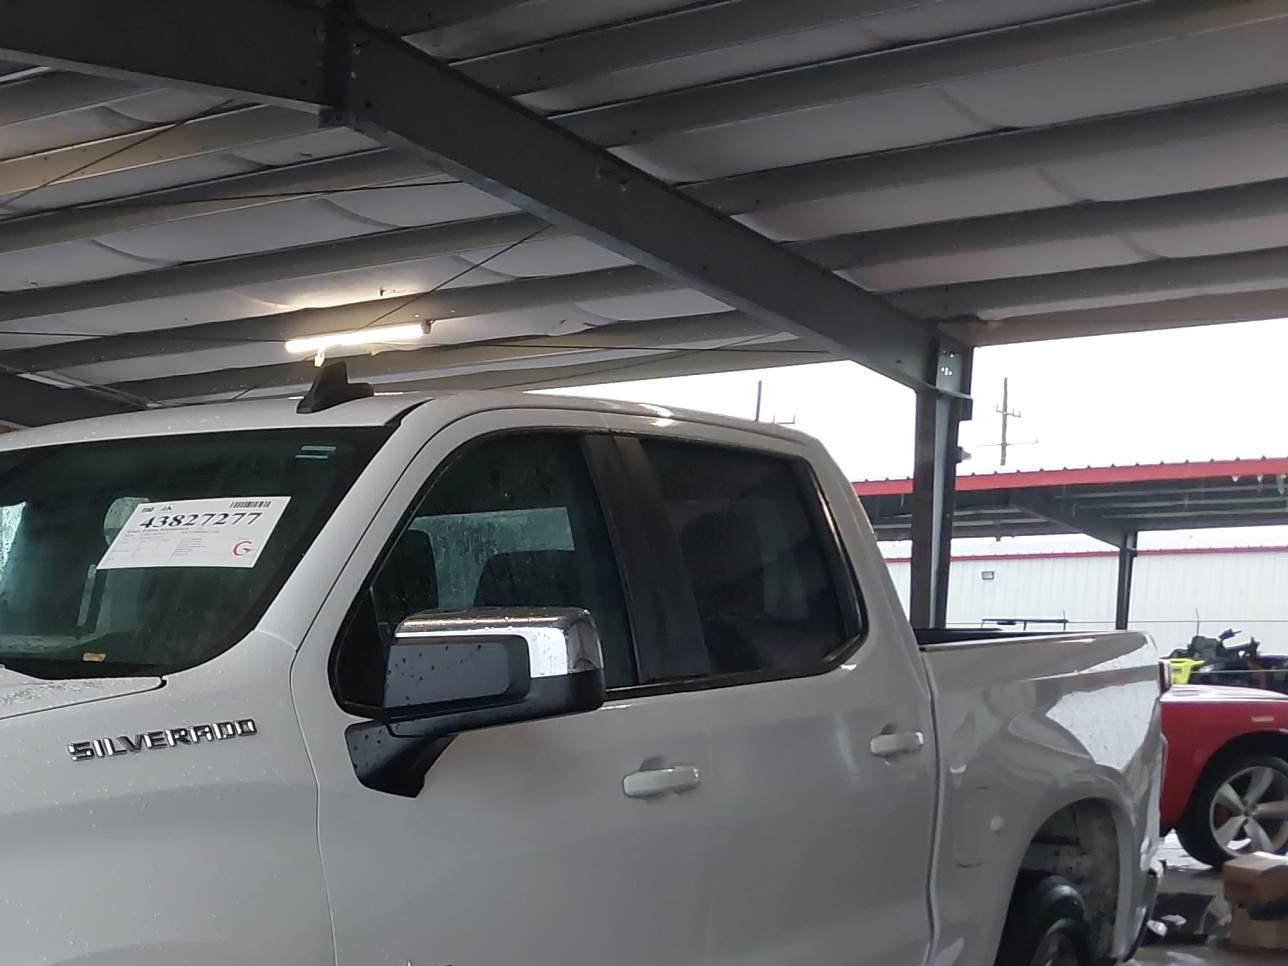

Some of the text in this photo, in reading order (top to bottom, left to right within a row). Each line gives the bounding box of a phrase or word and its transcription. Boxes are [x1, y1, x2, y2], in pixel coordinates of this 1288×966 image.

[140, 511, 263, 529] 43827277
[233, 540, 254, 557] G
[67, 718, 259, 762] SILVERADO
